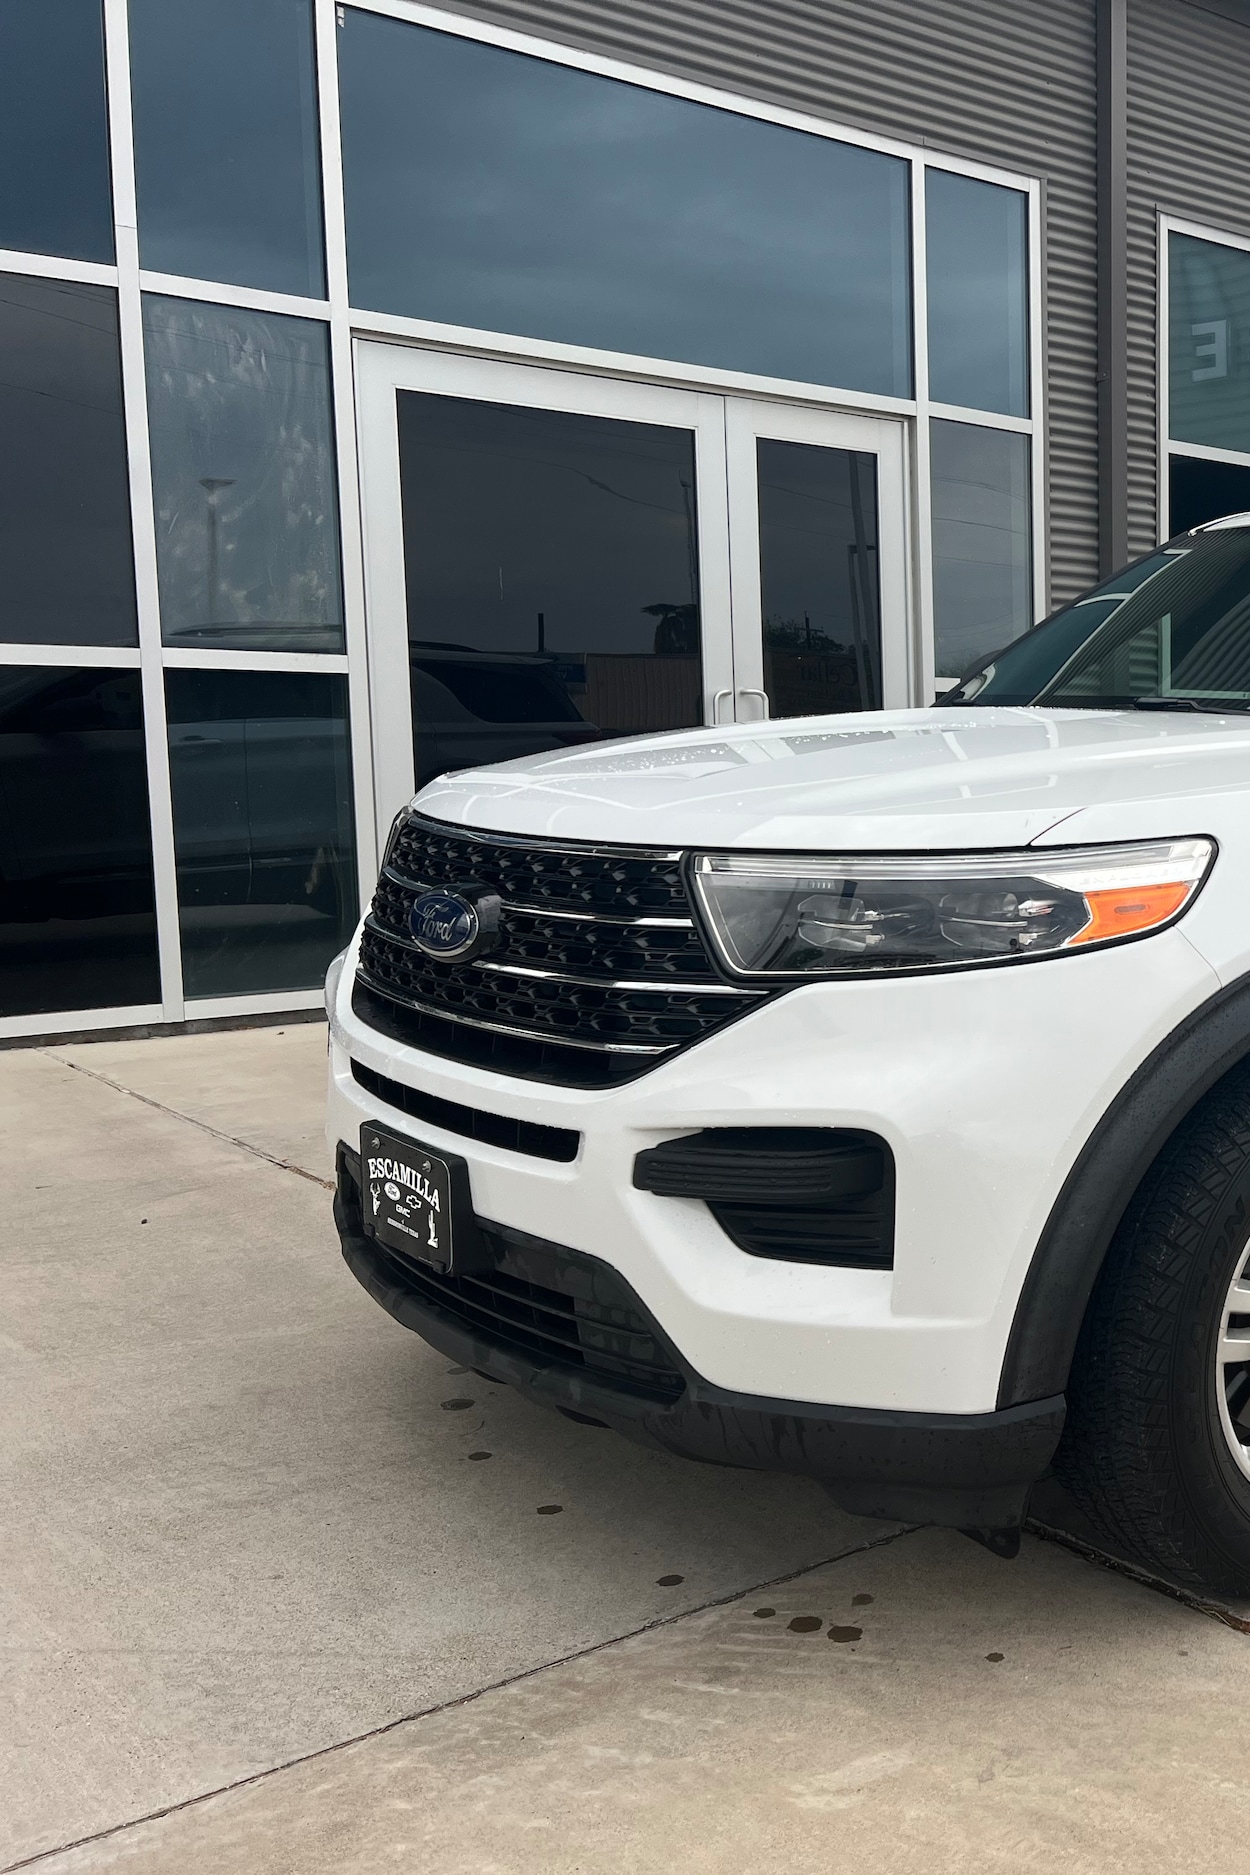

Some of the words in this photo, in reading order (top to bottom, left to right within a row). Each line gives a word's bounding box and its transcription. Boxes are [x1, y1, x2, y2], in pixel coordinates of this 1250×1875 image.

[417, 902, 457, 941] Ford
[367, 1157, 440, 1213] ESCAMILLA
[395, 1203, 411, 1218] GMC
